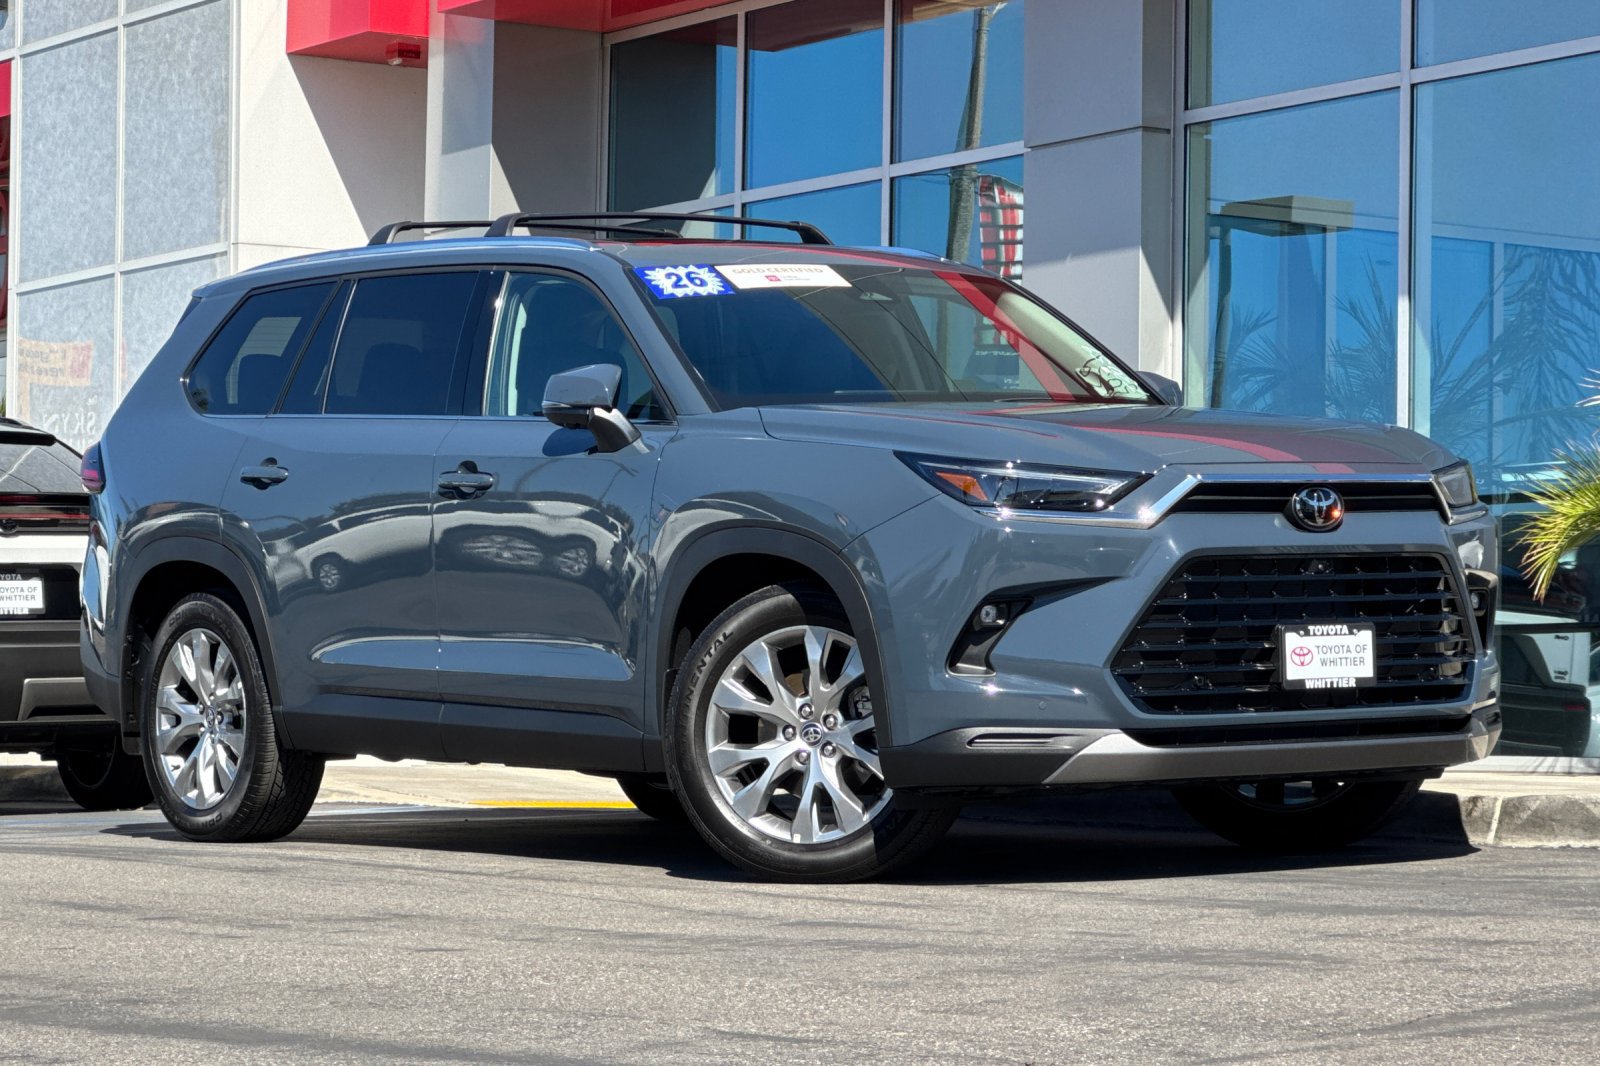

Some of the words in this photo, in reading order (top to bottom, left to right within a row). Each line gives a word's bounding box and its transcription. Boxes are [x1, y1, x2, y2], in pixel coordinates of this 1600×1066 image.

[665, 271, 708, 289] 26
[1308, 624, 1349, 636] TOYOTA
[1315, 644, 1352, 655] TOYOTA
[1354, 644, 1368, 654] OF
[1320, 656, 1366, 667] WHITTIER
[1304, 677, 1356, 689] WHITTIER
